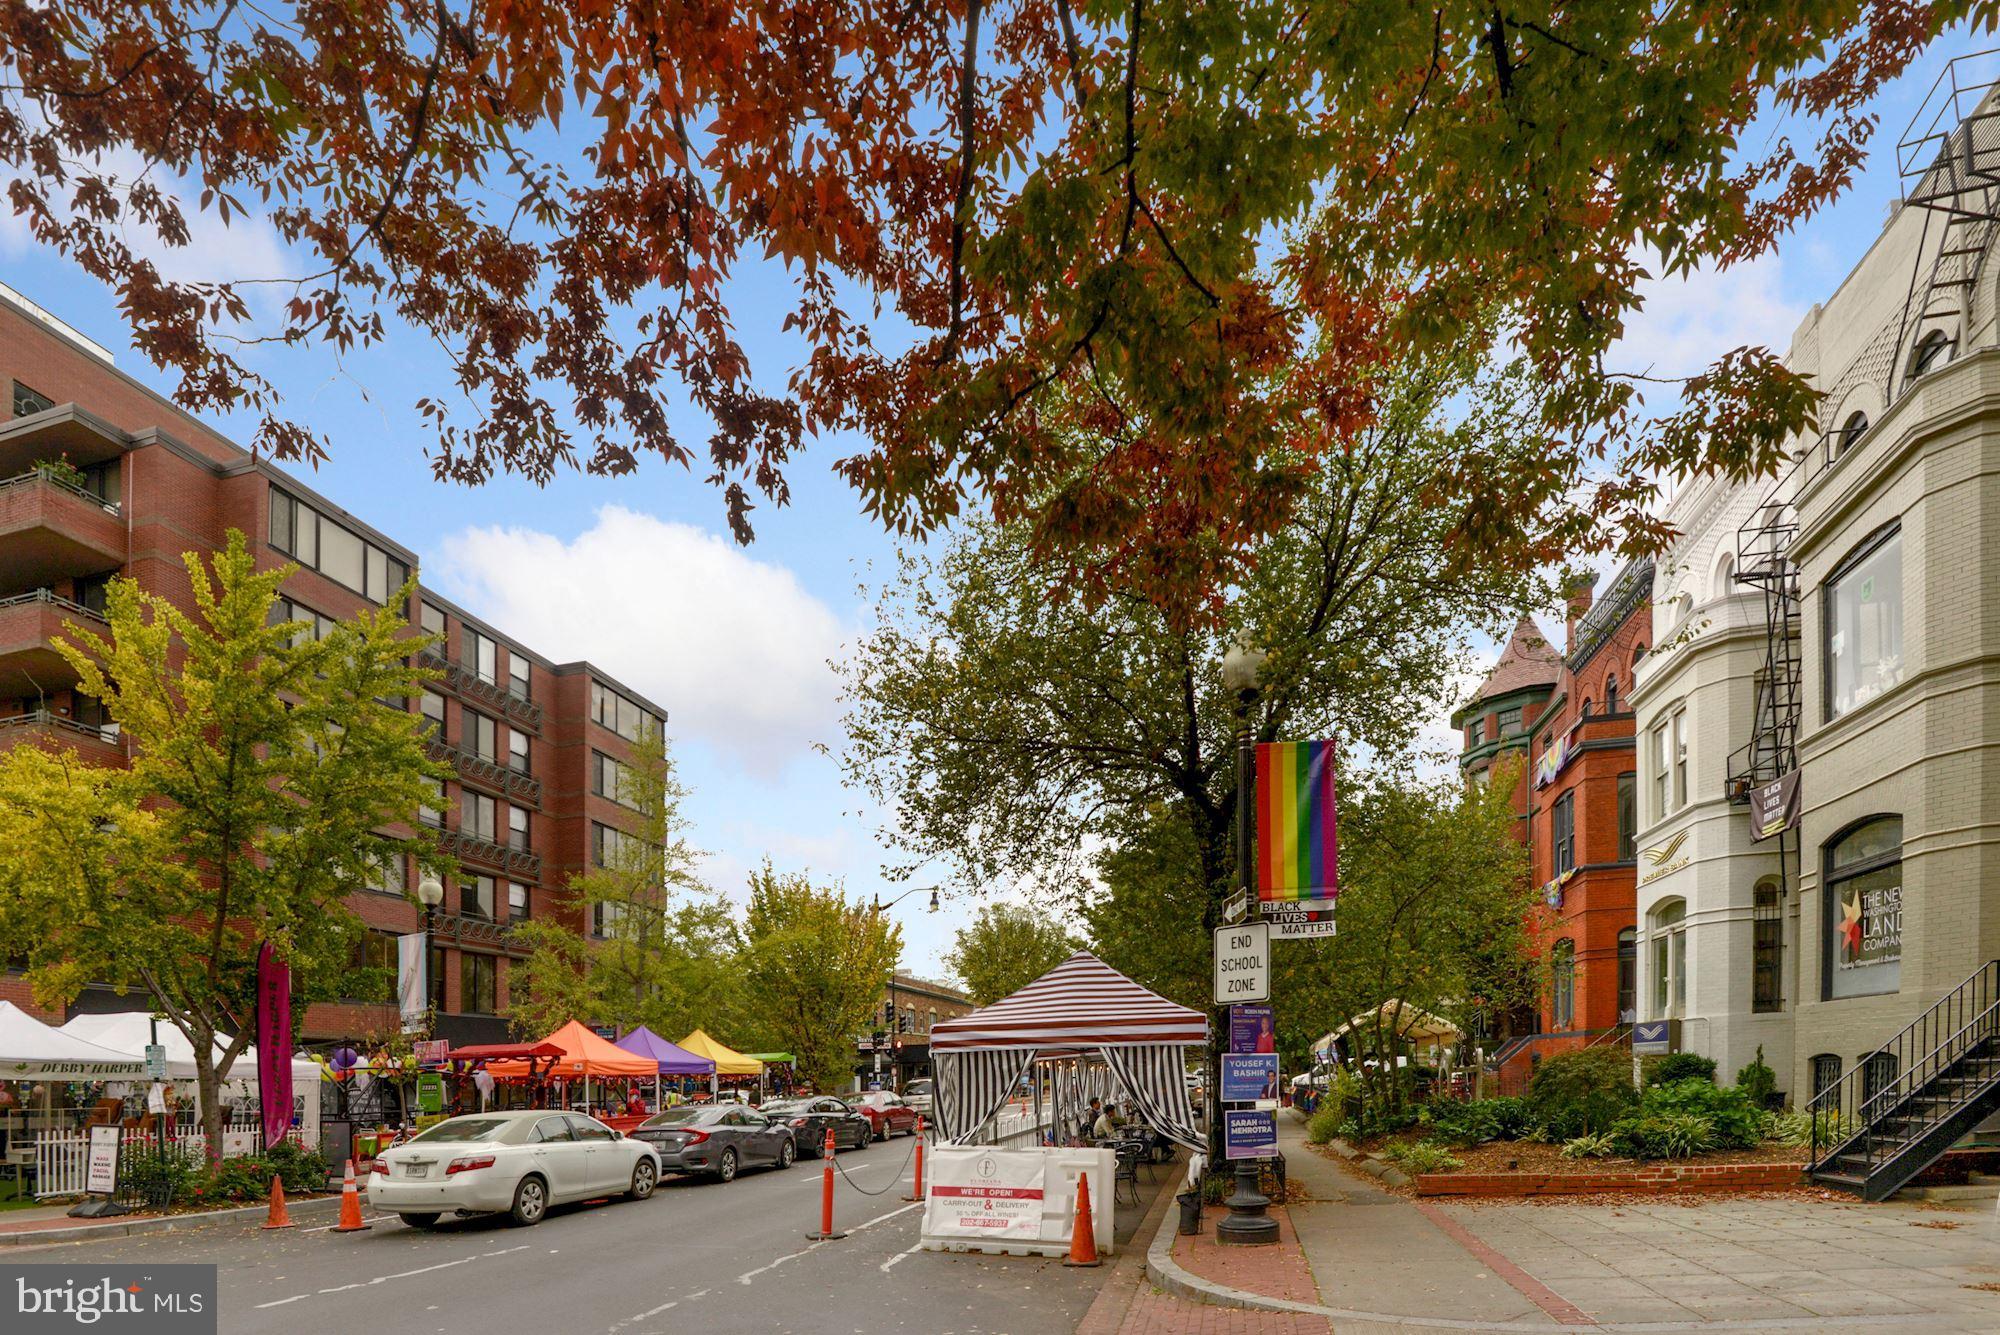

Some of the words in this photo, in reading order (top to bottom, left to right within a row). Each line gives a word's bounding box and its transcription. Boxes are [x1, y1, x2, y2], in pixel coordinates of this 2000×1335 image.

[1764, 782, 1782, 798] BLACK
[1764, 795, 1780, 810] LIVES
[1764, 805, 1786, 822] MATTER
[1863, 891, 1881, 909] THE
[1262, 902, 1301, 912] BLACK
[1273, 912, 1308, 923] LIVES
[1281, 922, 1333, 934] MATTER
[1231, 935, 1252, 949] END
[1221, 956, 1262, 972] SCHOOL
[1228, 978, 1255, 993] ZONE
[40, 1063, 90, 1074] DEBBY
[91, 1063, 143, 1074] HARPER
[1231, 1119, 1257, 1127] SARAH
[1231, 1126, 1272, 1134] MEHROTRA
[960, 1188, 984, 1196] WE'RE
[984, 1200, 993, 1210] &
[996, 1201, 1029, 1209] DELIVERY
